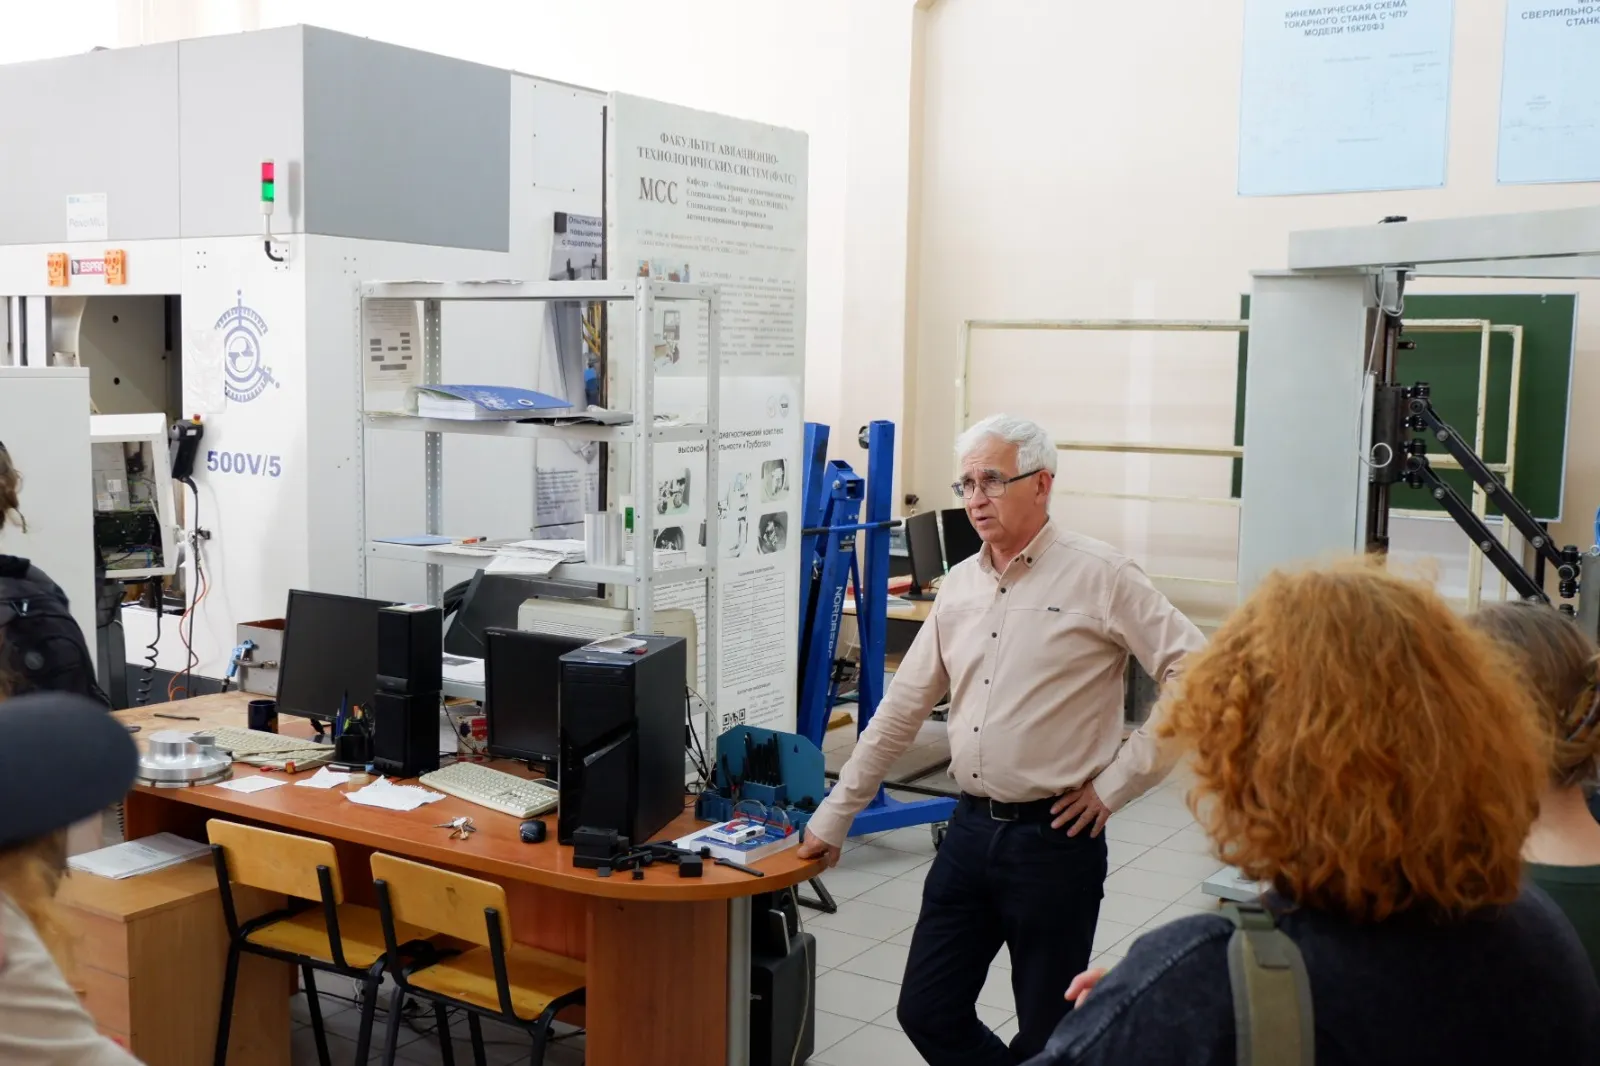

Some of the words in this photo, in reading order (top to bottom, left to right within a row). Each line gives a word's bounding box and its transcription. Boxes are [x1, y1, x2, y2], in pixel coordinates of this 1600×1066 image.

[1284, 17, 1338, 29] ТОКАРНОГО
[1340, 13, 1377, 24] СТАНКА
[1379, 12, 1386, 20] С
[1389, 10, 1408, 19] ЧПУ
[1285, 4, 1372, 19] КИНЕМАТИЧЕСКАЯ
[1374, 0, 1407, 10] СХЕМА
[1304, 26, 1344, 36] МОДЕЛИ
[660, 132, 716, 153] ФАКУЛЬТЕТ
[637, 146, 734, 173] ТЕХНОЛОГИЧЕСКИХ
[638, 177, 678, 205] МСС
[207, 450, 281, 478] 500V/5
